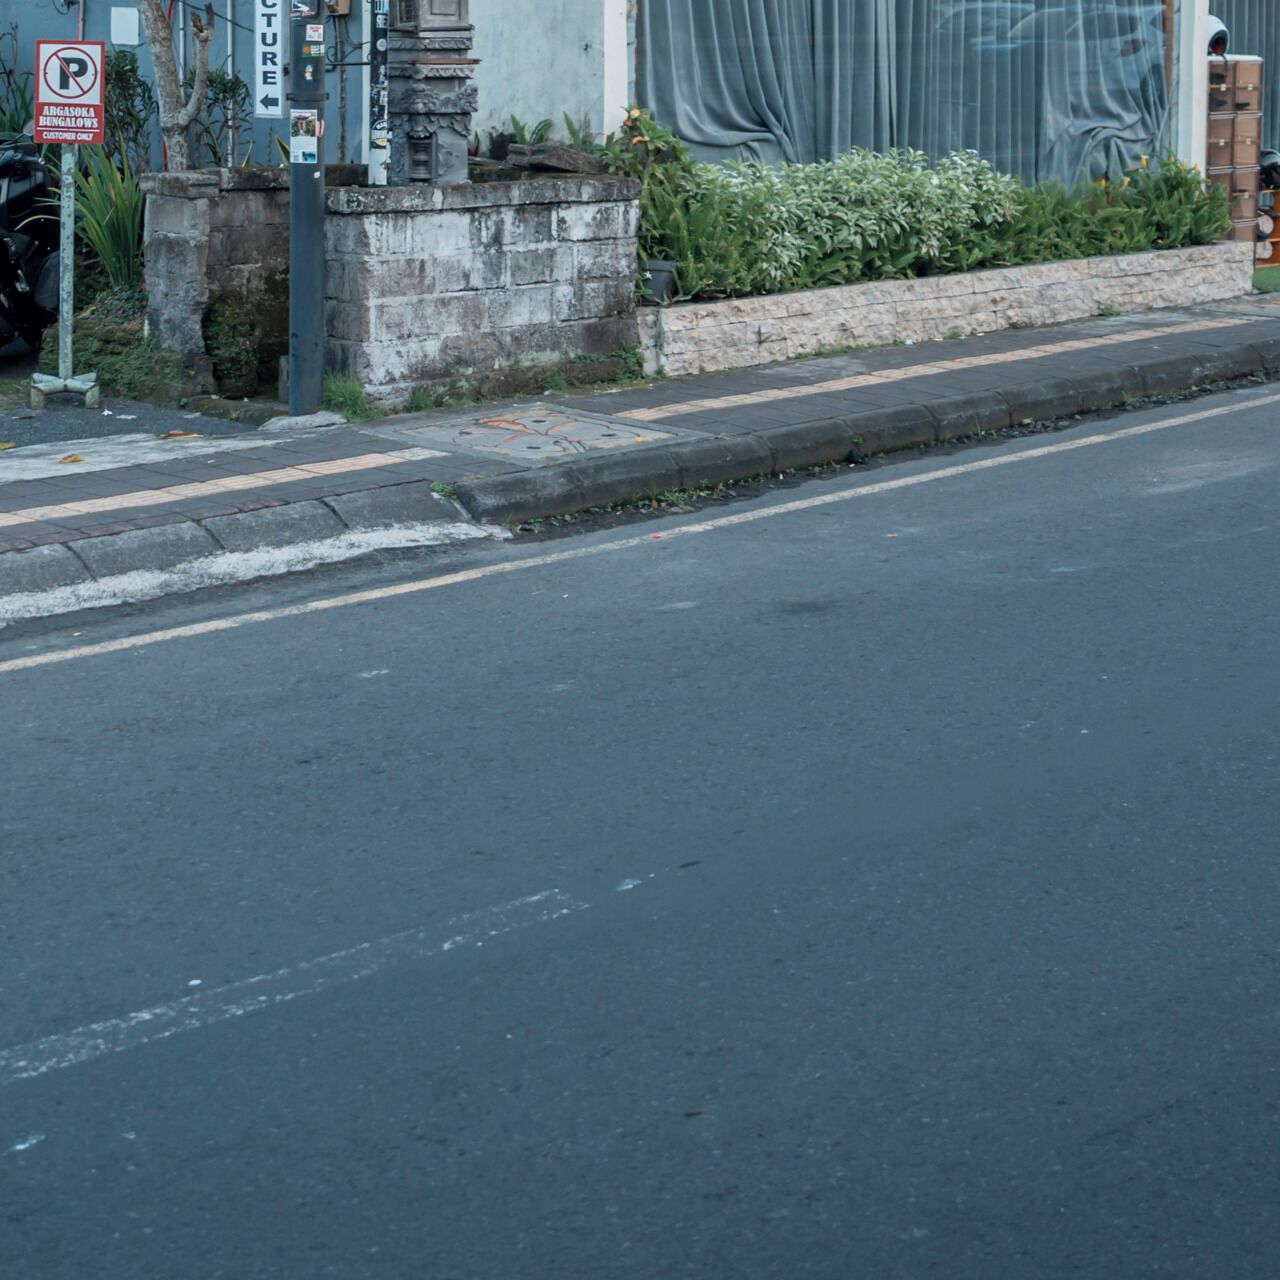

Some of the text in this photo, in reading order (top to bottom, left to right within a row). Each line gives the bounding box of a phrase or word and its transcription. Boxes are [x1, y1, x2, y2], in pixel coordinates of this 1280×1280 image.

[42, 106, 95, 117] ARGASOKA
[39, 116, 98, 128] BUNGALOWS
[42, 131, 93, 141] CUSTOMER ONLY
